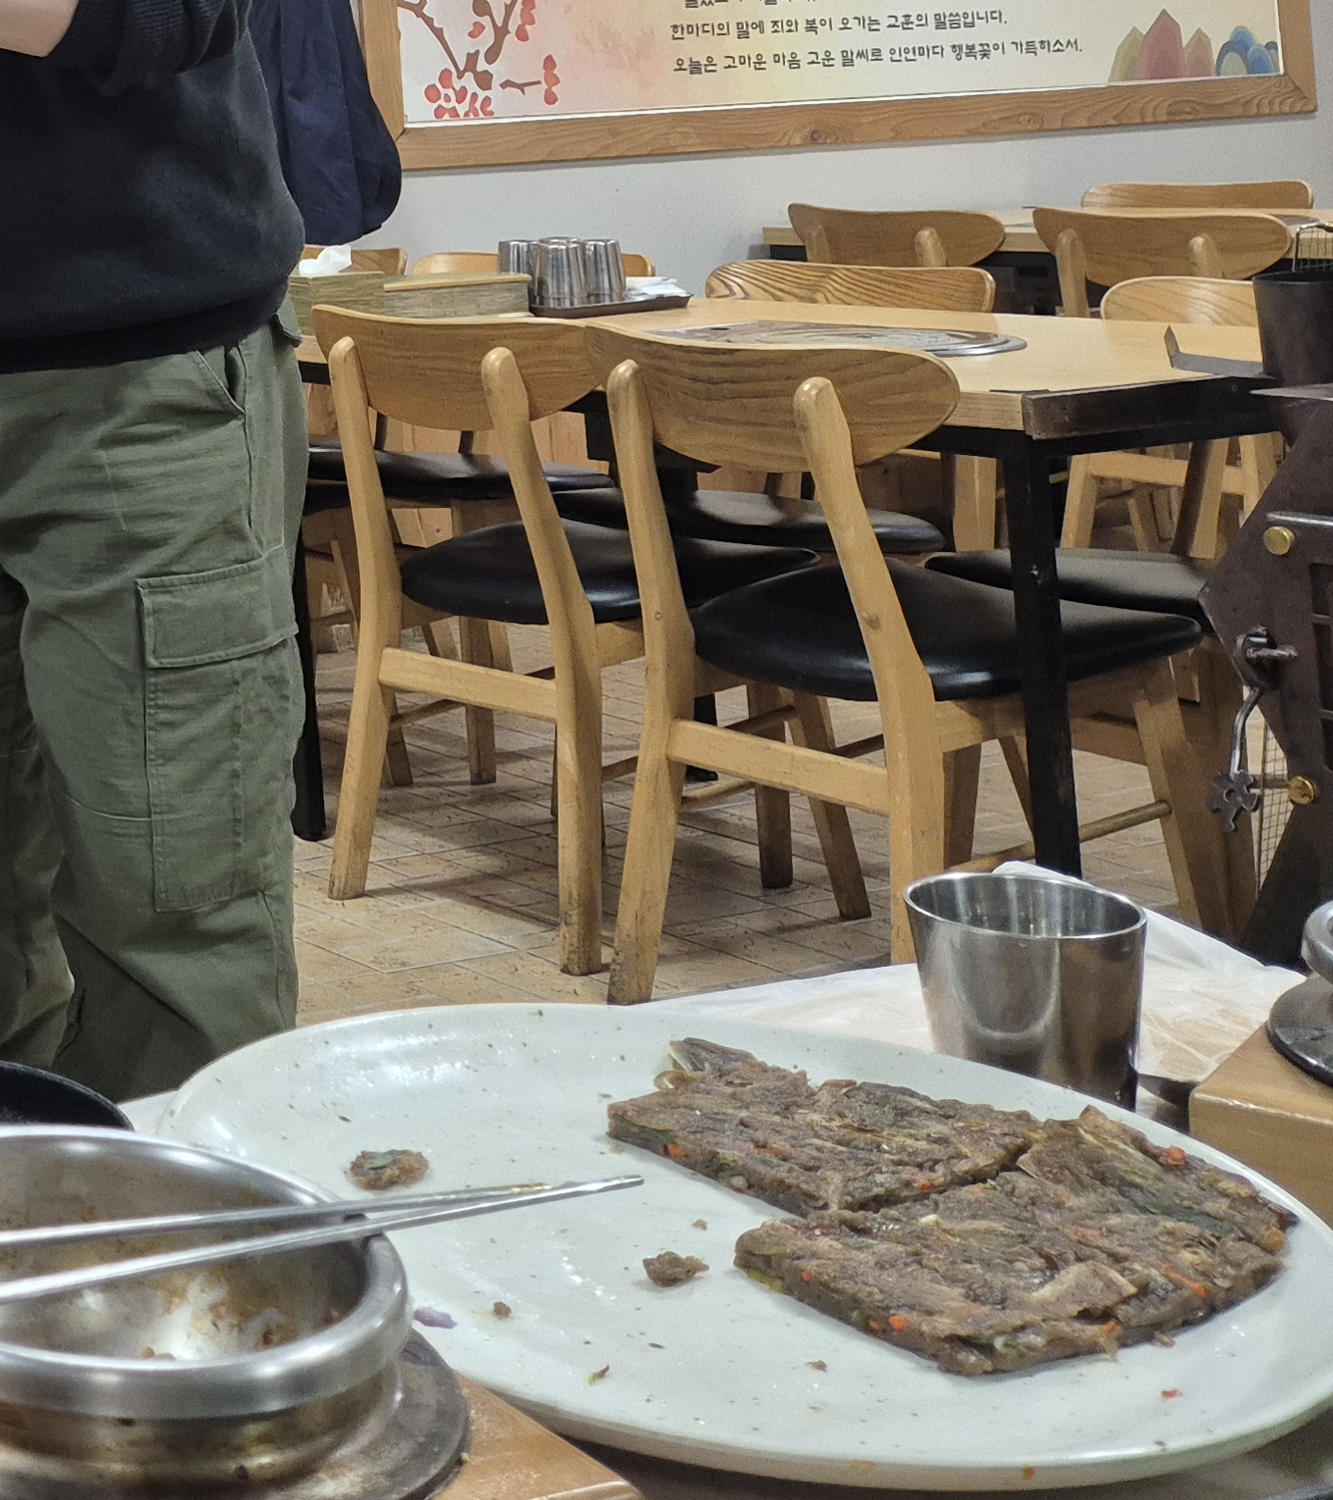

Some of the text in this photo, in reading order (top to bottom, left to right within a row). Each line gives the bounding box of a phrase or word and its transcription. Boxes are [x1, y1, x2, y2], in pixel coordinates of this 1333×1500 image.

[669, 21, 731, 40] 한마디의
[735, 19, 766, 39] 말에
[770, 18, 799, 33] 죄와
[803, 16, 833, 35] 복이
[838, 15, 882, 32] 오가는
[933, 9, 1008, 30] 말씀입니다.
[672, 37, 1083, 75] 오늘은 고마운 마음 고운 말씨로 인연마다 행복꽃이 가득하소서.
